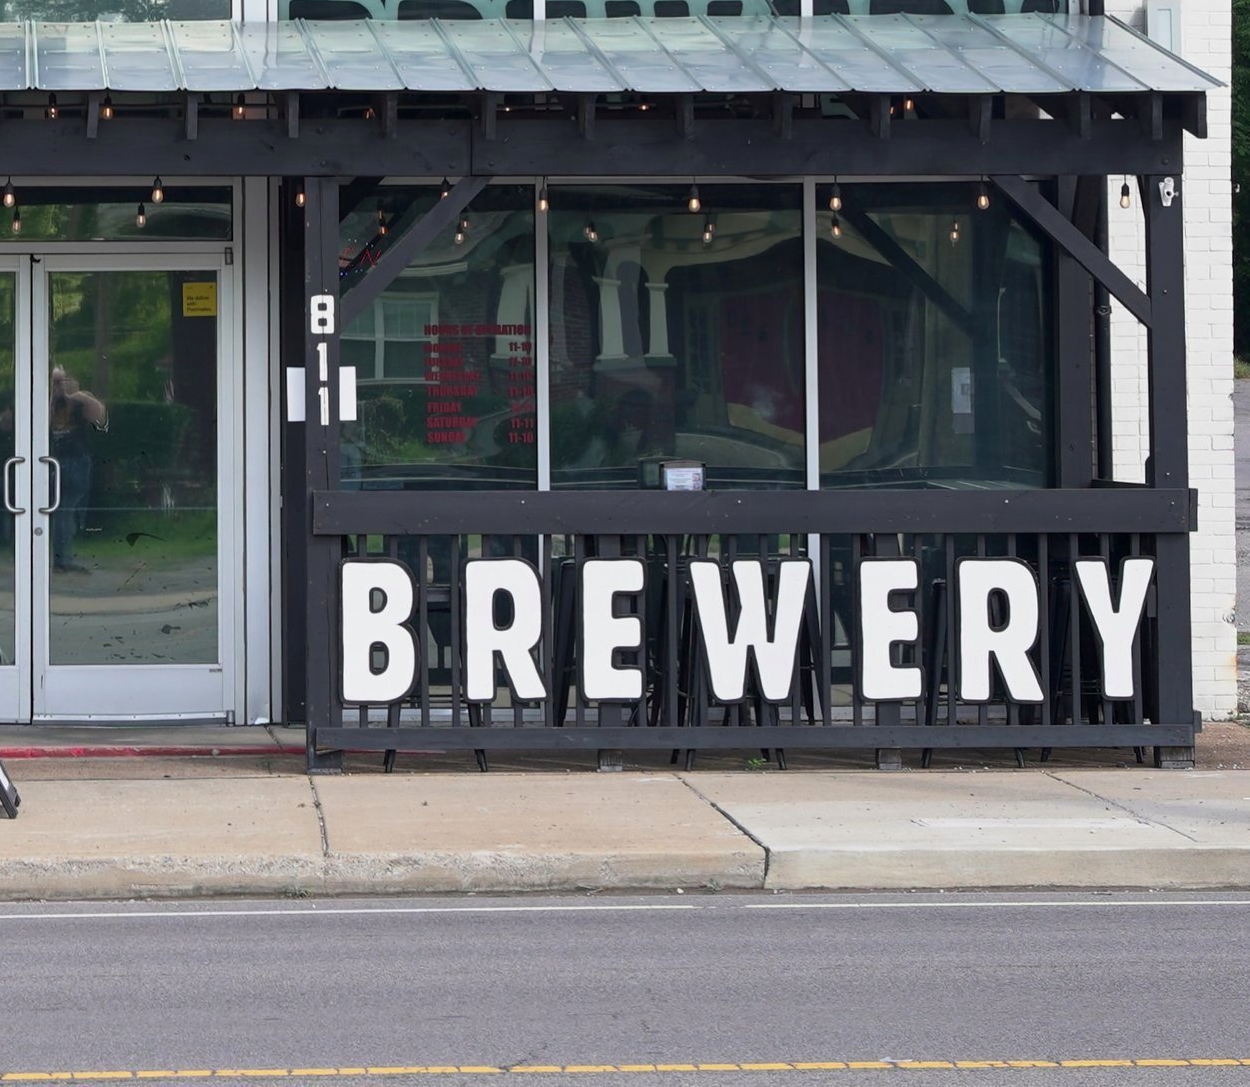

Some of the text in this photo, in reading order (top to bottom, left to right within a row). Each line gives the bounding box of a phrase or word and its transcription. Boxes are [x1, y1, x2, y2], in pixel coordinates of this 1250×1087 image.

[424, 324, 459, 336] HOURS
[475, 324, 531, 336] OPERATION
[426, 385, 478, 397] THURSDAY
[426, 401, 462, 413] FRIDAY
[426, 416, 479, 429] SATURDAY
[426, 431, 467, 443] SUNDAY
[341, 558, 1156, 704] BREWERY
